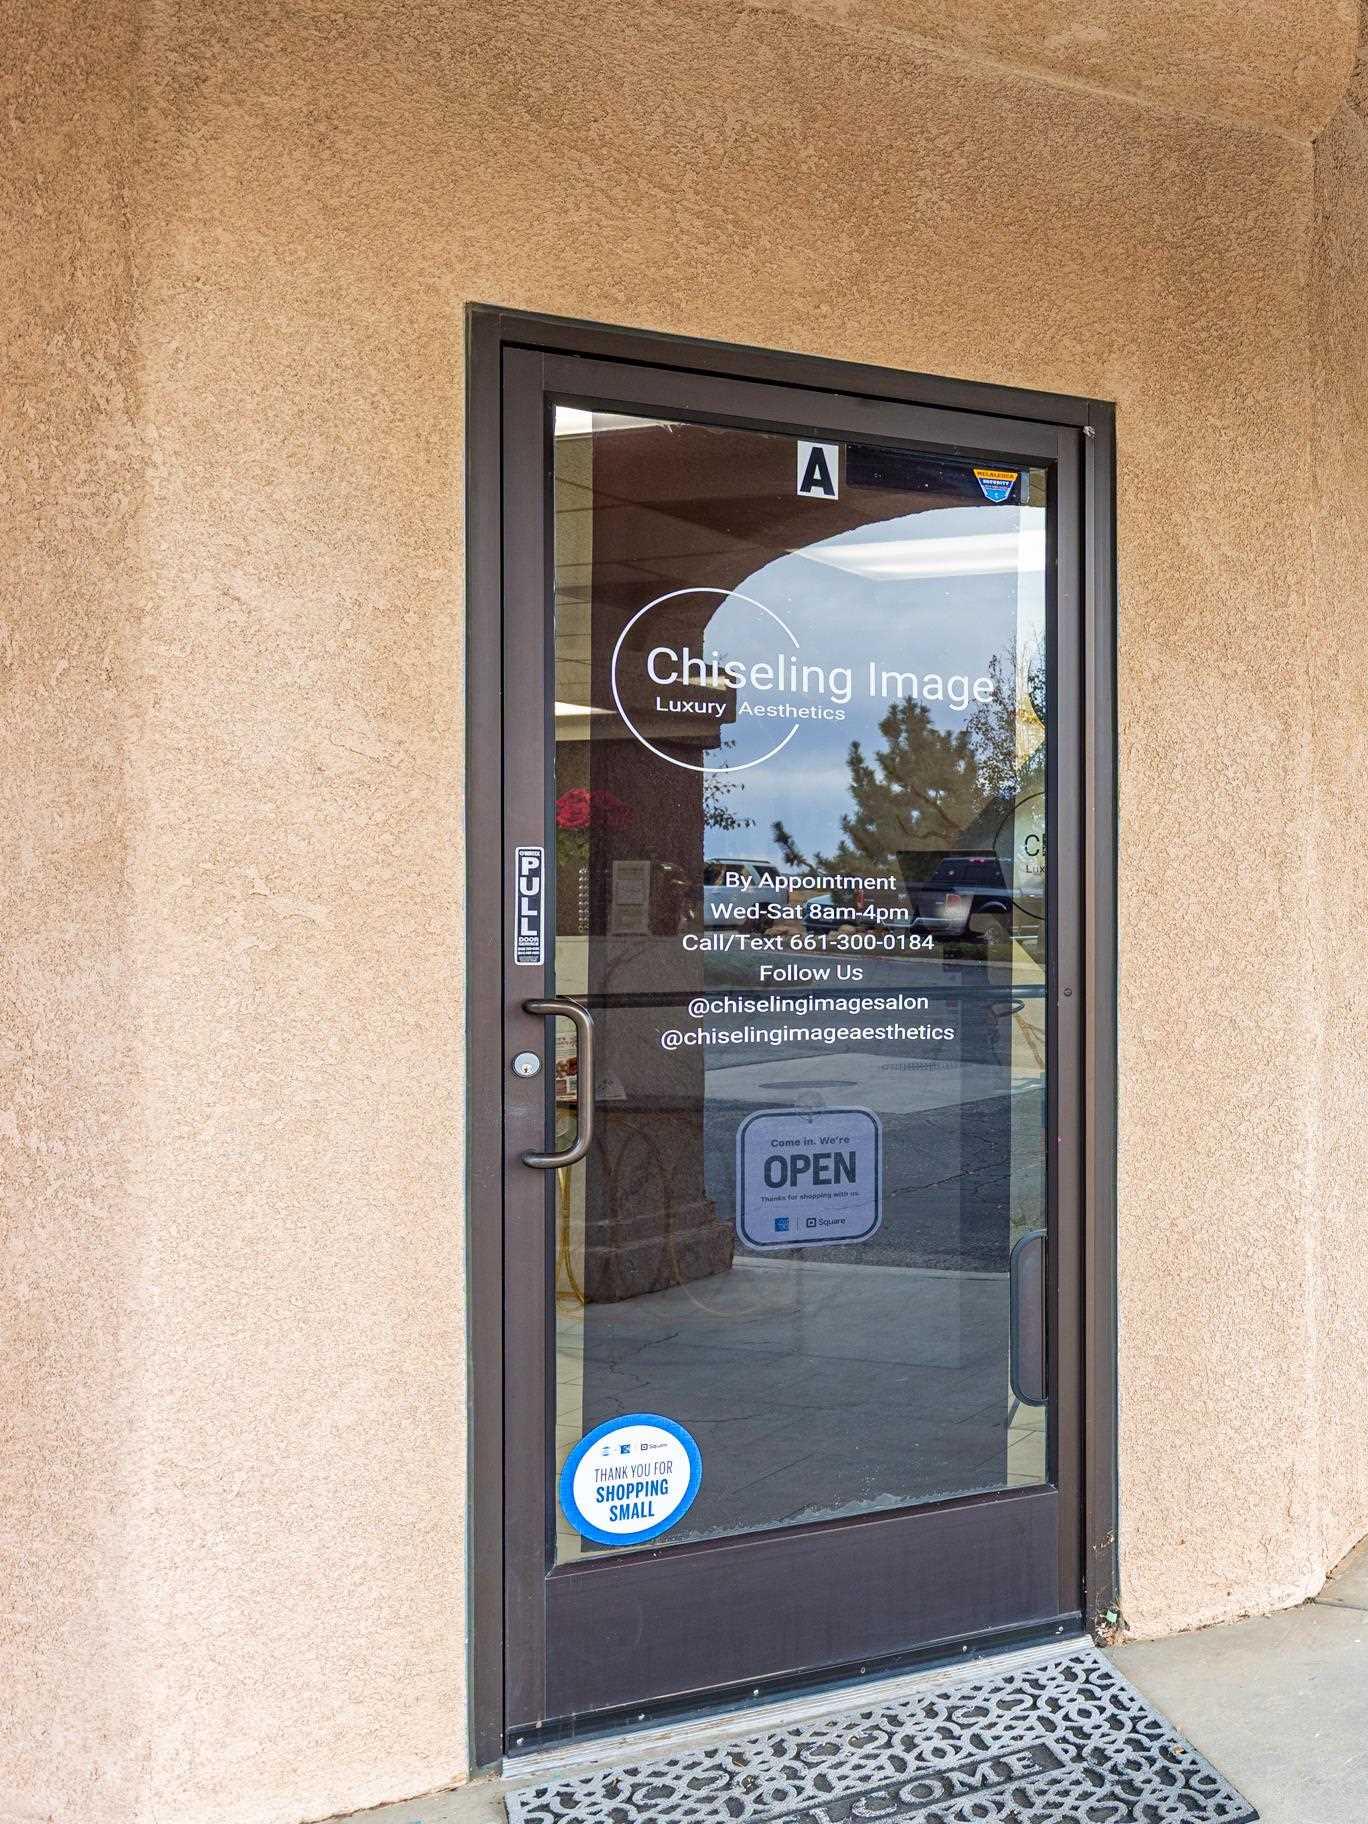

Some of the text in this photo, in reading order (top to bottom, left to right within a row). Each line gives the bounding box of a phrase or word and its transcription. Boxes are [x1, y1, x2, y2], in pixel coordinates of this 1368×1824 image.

[800, 446, 836, 496] A
[647, 647, 994, 712] Chiseling Image
[656, 697, 846, 721] Luxury Aesthetics
[726, 871, 897, 893] By Appointment
[519, 857, 540, 936] PULL
[711, 903, 909, 924] Wed-Sat 8am-4pm
[682, 934, 935, 952] Call/Text 661-300-0184
[760, 964, 863, 981] Follow Us
[688, 994, 929, 1018] @chiselingimagesalon
[661, 1023, 955, 1051] @chiselingimageaesthetics
[771, 1136, 850, 1148] Come in. We're
[764, 1151, 856, 1188] OPEN
[595, 1460, 673, 1483] THANK YOU FOR
[596, 1478, 669, 1503] SHOPPING
[609, 1501, 655, 1522] SMALL
